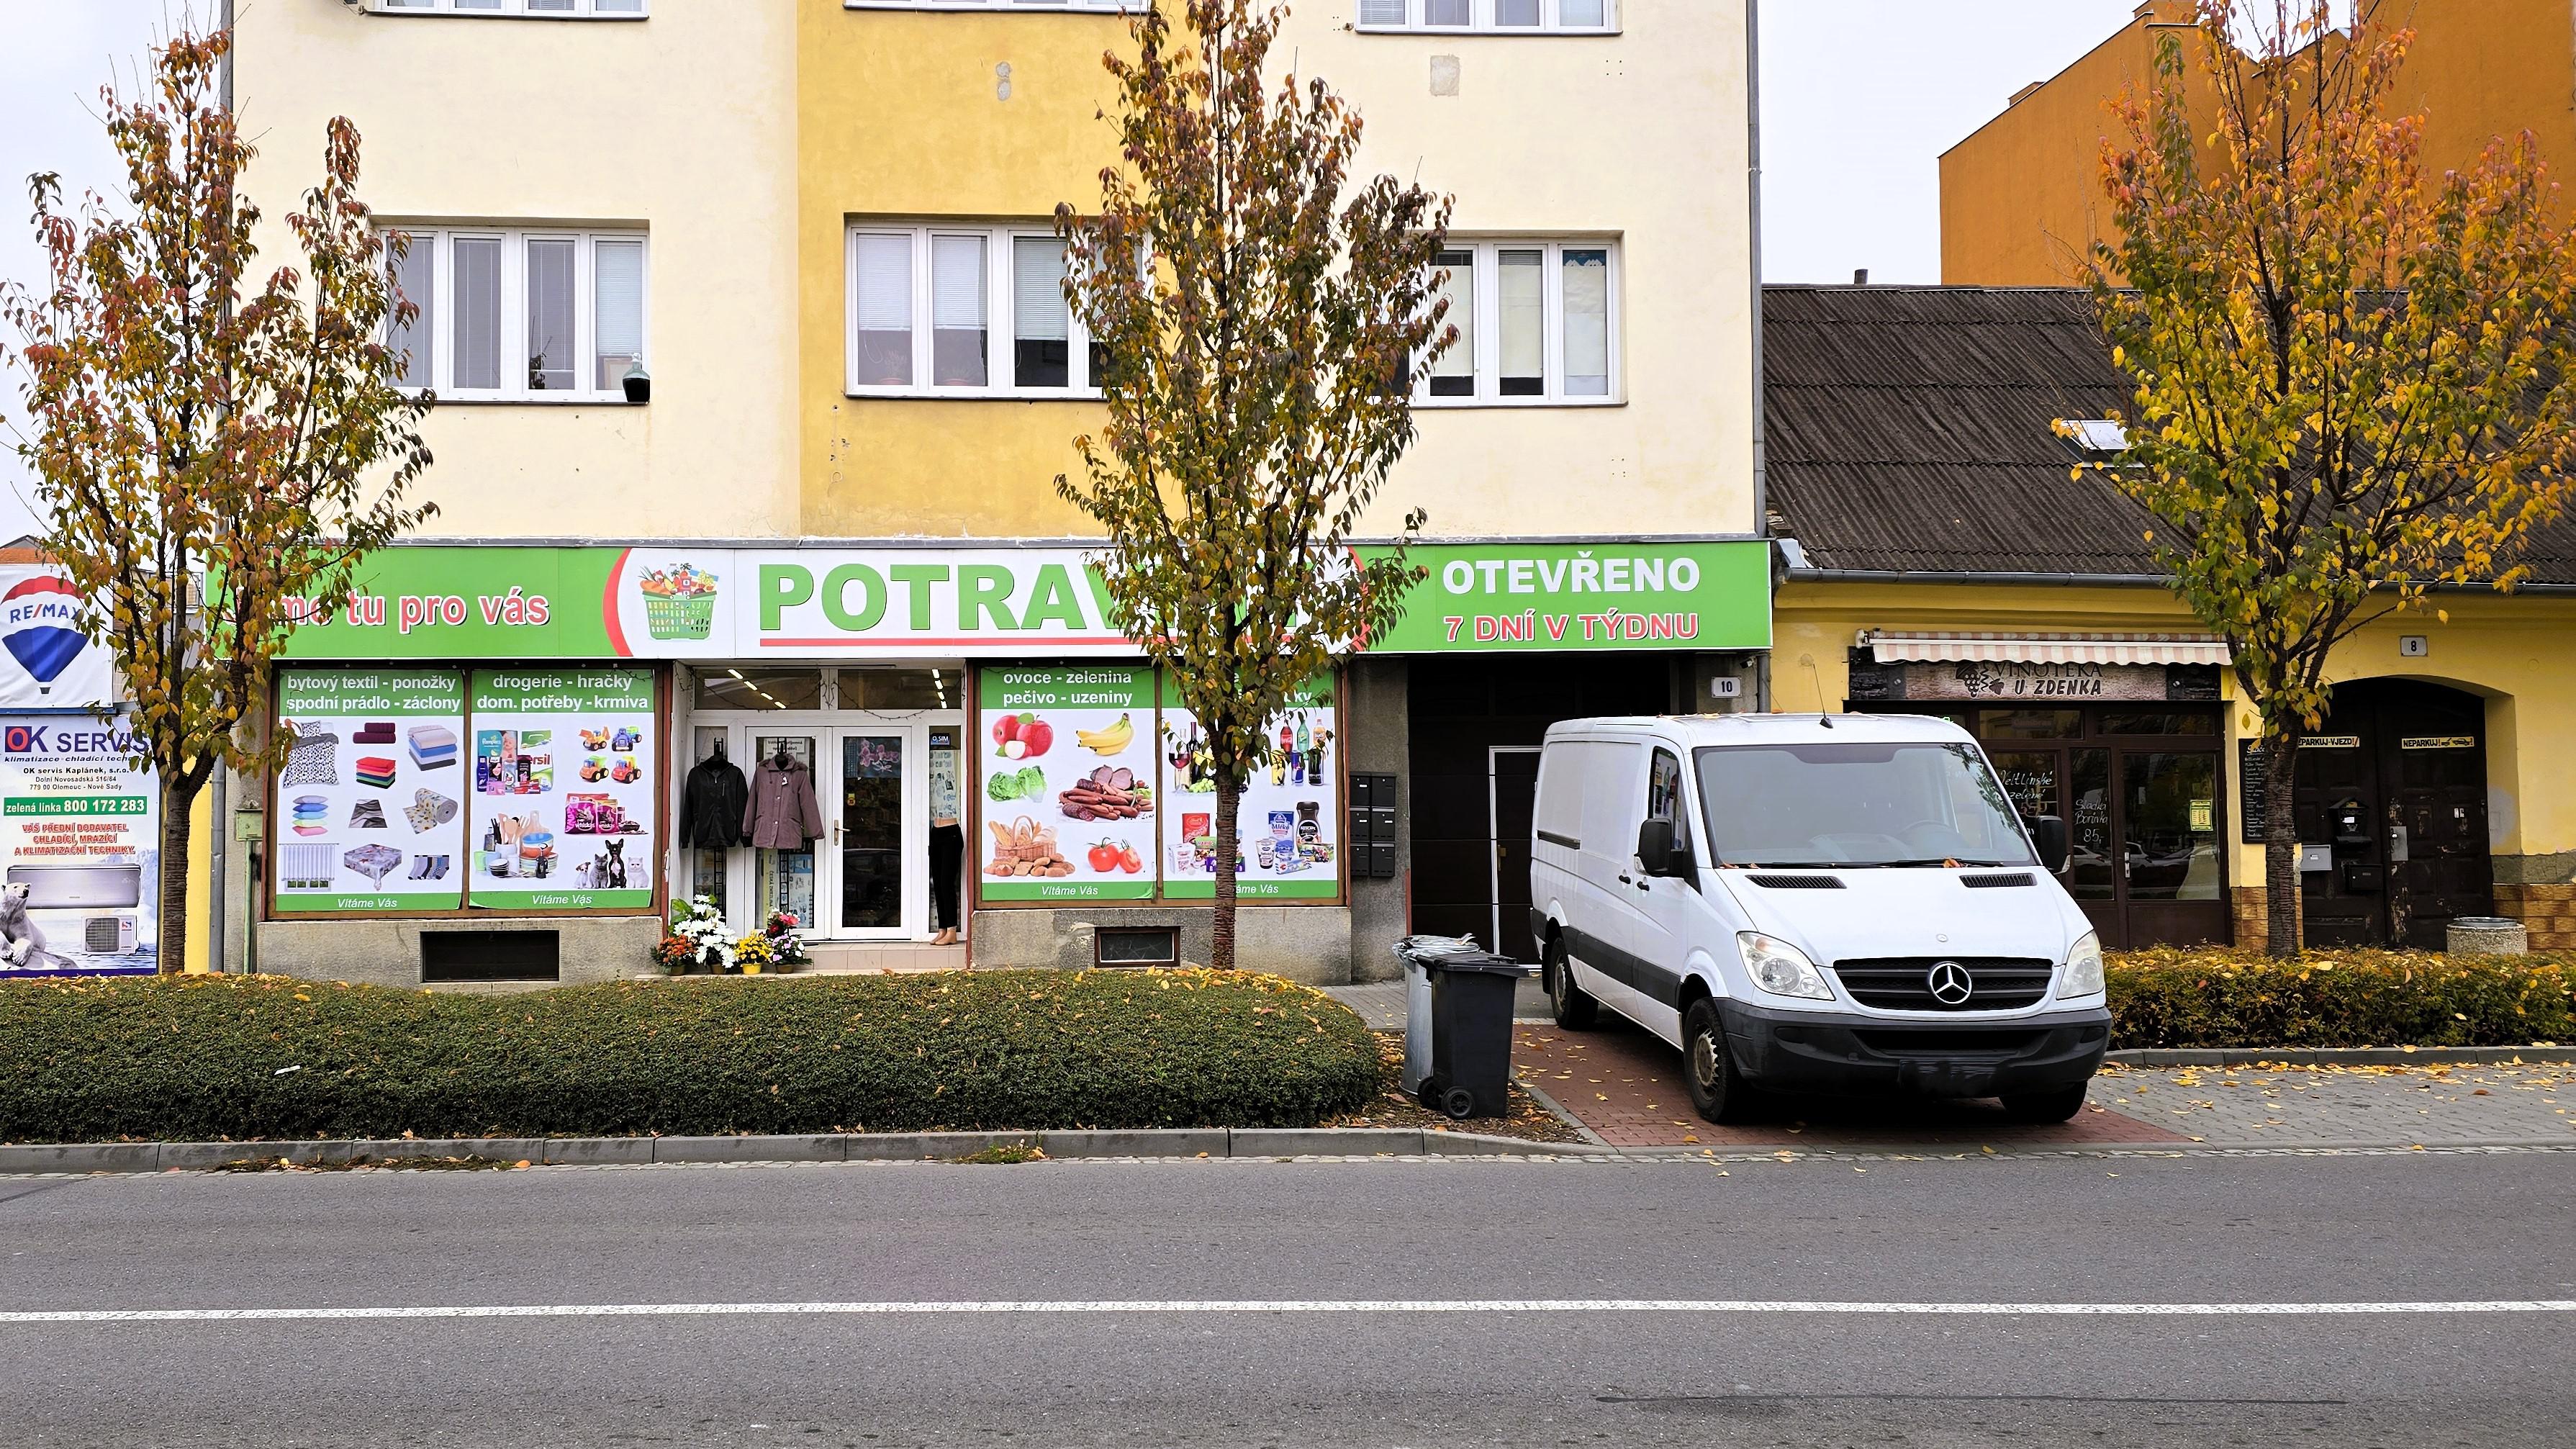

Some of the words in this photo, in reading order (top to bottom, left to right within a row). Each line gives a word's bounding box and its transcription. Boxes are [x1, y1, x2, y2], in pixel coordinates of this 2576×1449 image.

[1442, 550, 1701, 595] OTEVŘENO
[759, 564, 1311, 631] POTRAV
[346, 588, 386, 626] tu
[398, 594, 467, 634] pro
[478, 586, 551, 626] vás
[1443, 616, 1464, 642] 7
[1474, 608, 1537, 641] DNÍ
[1545, 613, 1570, 641] V
[1578, 607, 1699, 641] TÝDNU
[2410, 640, 2417, 652] 8
[287, 675, 338, 692] bytový
[342, 675, 378, 689] textil
[392, 675, 456, 692] ponožky
[493, 674, 562, 692] drogerie
[577, 674, 632, 692] hračky
[1003, 673, 1052, 684] ovoce
[1066, 670, 1131, 684] zelenina
[1721, 680, 1733, 693] 10
[2015, 679, 2025, 695] U
[2033, 679, 2101, 695] ZDENKA
[286, 695, 338, 712] spodní
[343, 695, 390, 712] prádlo
[402, 695, 461, 712] záclony
[476, 695, 518, 708] dom.
[521, 694, 582, 711] potřeby
[594, 695, 648, 708] krmiva
[1003, 690, 1056, 707] pečivo
[1071, 690, 1132, 707] uzeniny
[5, 726, 49, 752] OK
[2299, 738, 2354, 746] EPARKUJ-VJEZD!
[2404, 739, 2441, 747] NEPARKUJ!
[6, 803, 36, 813] zelená
[39, 803, 61, 813] linka
[63, 800, 88, 813] 800
[92, 799, 116, 812] 172
[120, 799, 145, 811] 283
[22, 823, 40, 834] VÁŠ
[42, 822, 76, 833] PŘEDNÍ
[77, 823, 130, 833] DODAVATEL
[80, 833, 117, 844] MRAZÍCÍ
[14, 847, 22, 857] A
[23, 845, 86, 856] KLIMATIZAČNÍ
[1041, 885, 1076, 896] Vítáme
[1079, 885, 1098, 896] Vás
[1260, 884, 1279, 893] Vás
[337, 898, 374, 908] Vítáme
[377, 898, 398, 908] Vás
[532, 895, 568, 905] Vítáme
[572, 894, 592, 905] Vás
